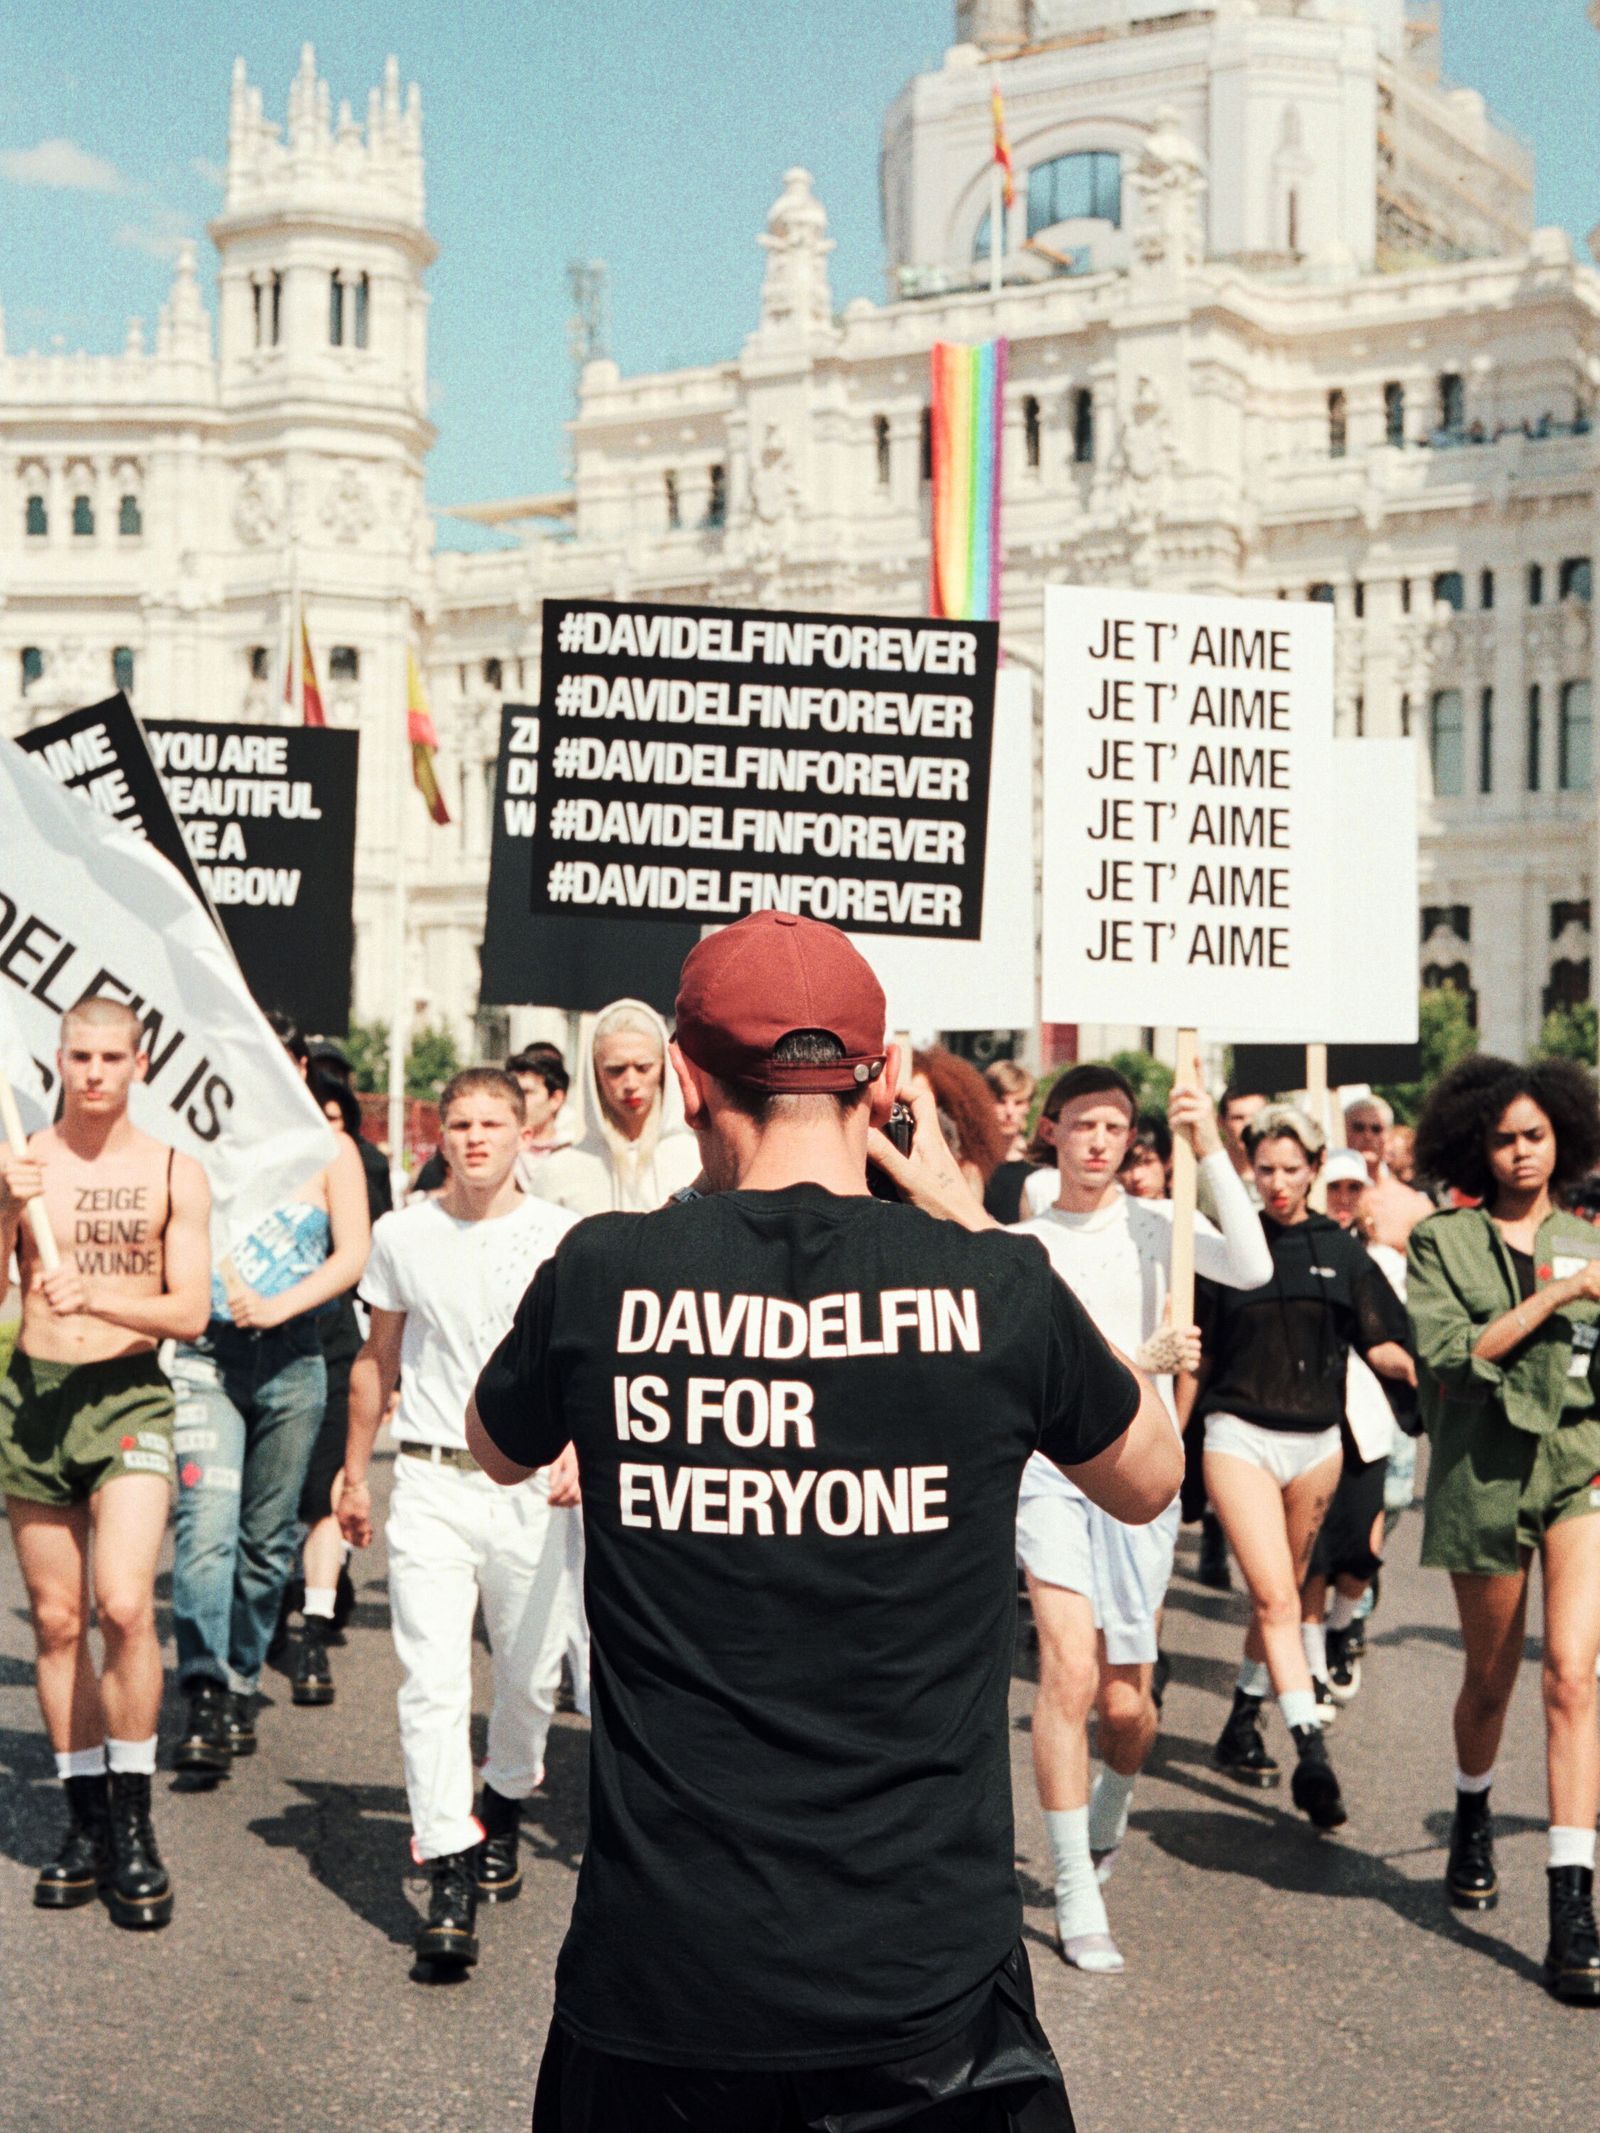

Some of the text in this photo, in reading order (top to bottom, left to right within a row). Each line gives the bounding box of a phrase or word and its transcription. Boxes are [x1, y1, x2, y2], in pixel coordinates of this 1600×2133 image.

[558, 613, 977, 675] #DAVIDELFINFOREVER
[1089, 620, 1133, 660] JE
[1191, 626, 1289, 671] AIME
[555, 675, 973, 738] #DAVIDELFINFOREVER
[1089, 680, 1133, 721] JE
[1190, 687, 1289, 730] AIME
[148, 731, 289, 775] YOU ARE
[553, 738, 969, 801] #DAVIDELFINFOREVER
[1088, 740, 1133, 780] JE
[1190, 746, 1289, 789] AIME
[217, 822, 247, 861] A
[550, 799, 965, 864] #DAVIDELFINFOREVER
[1088, 799, 1133, 840] JE
[1190, 805, 1289, 848] AIME
[199, 865, 301, 907] NBOW
[547, 862, 962, 926] #DAVIDELFINFOREVER
[1087, 860, 1132, 901] JE
[1189, 865, 1288, 908] AIME
[1087, 920, 1132, 961] JE
[1189, 925, 1288, 967] AIME
[169, 1056, 235, 1142] IS
[75, 1186, 148, 1212] ZEIGE
[75, 1218, 148, 1245] DEINE
[75, 1249, 157, 1276] WUNDE
[617, 1288, 981, 1360] DAVIDELFIN
[614, 1375, 816, 1448] IS FOR
[619, 1462, 949, 1536] EVERYONE
